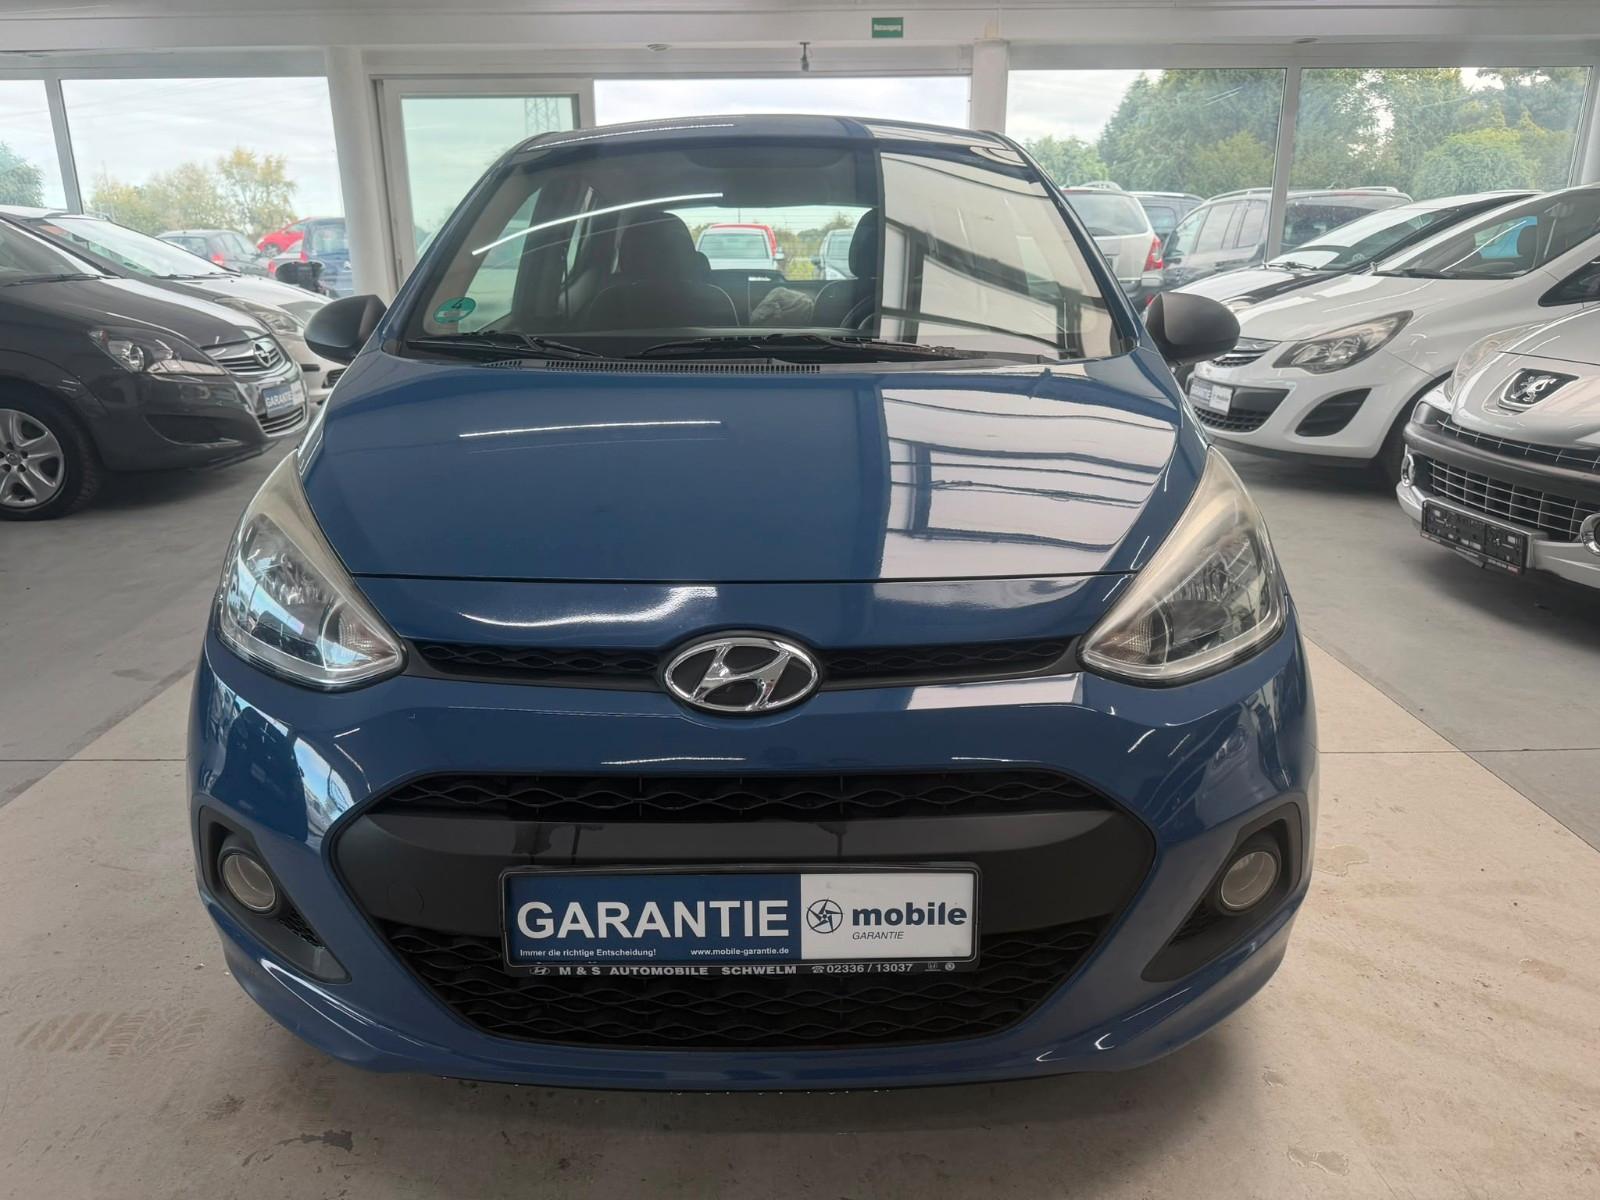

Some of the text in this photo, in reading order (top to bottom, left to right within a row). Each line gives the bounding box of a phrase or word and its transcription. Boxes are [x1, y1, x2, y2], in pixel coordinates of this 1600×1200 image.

[852, 902, 967, 926] mobile
[517, 900, 789, 939] GARANTIE
[852, 931, 904, 940] GARANTIE
[520, 949, 657, 958] Immer die richtige Entscheidung!
[691, 947, 789, 956] www.mobile-garantie.de
[559, 966, 797, 976] M & S AUTOMOBILE SCHWELM
